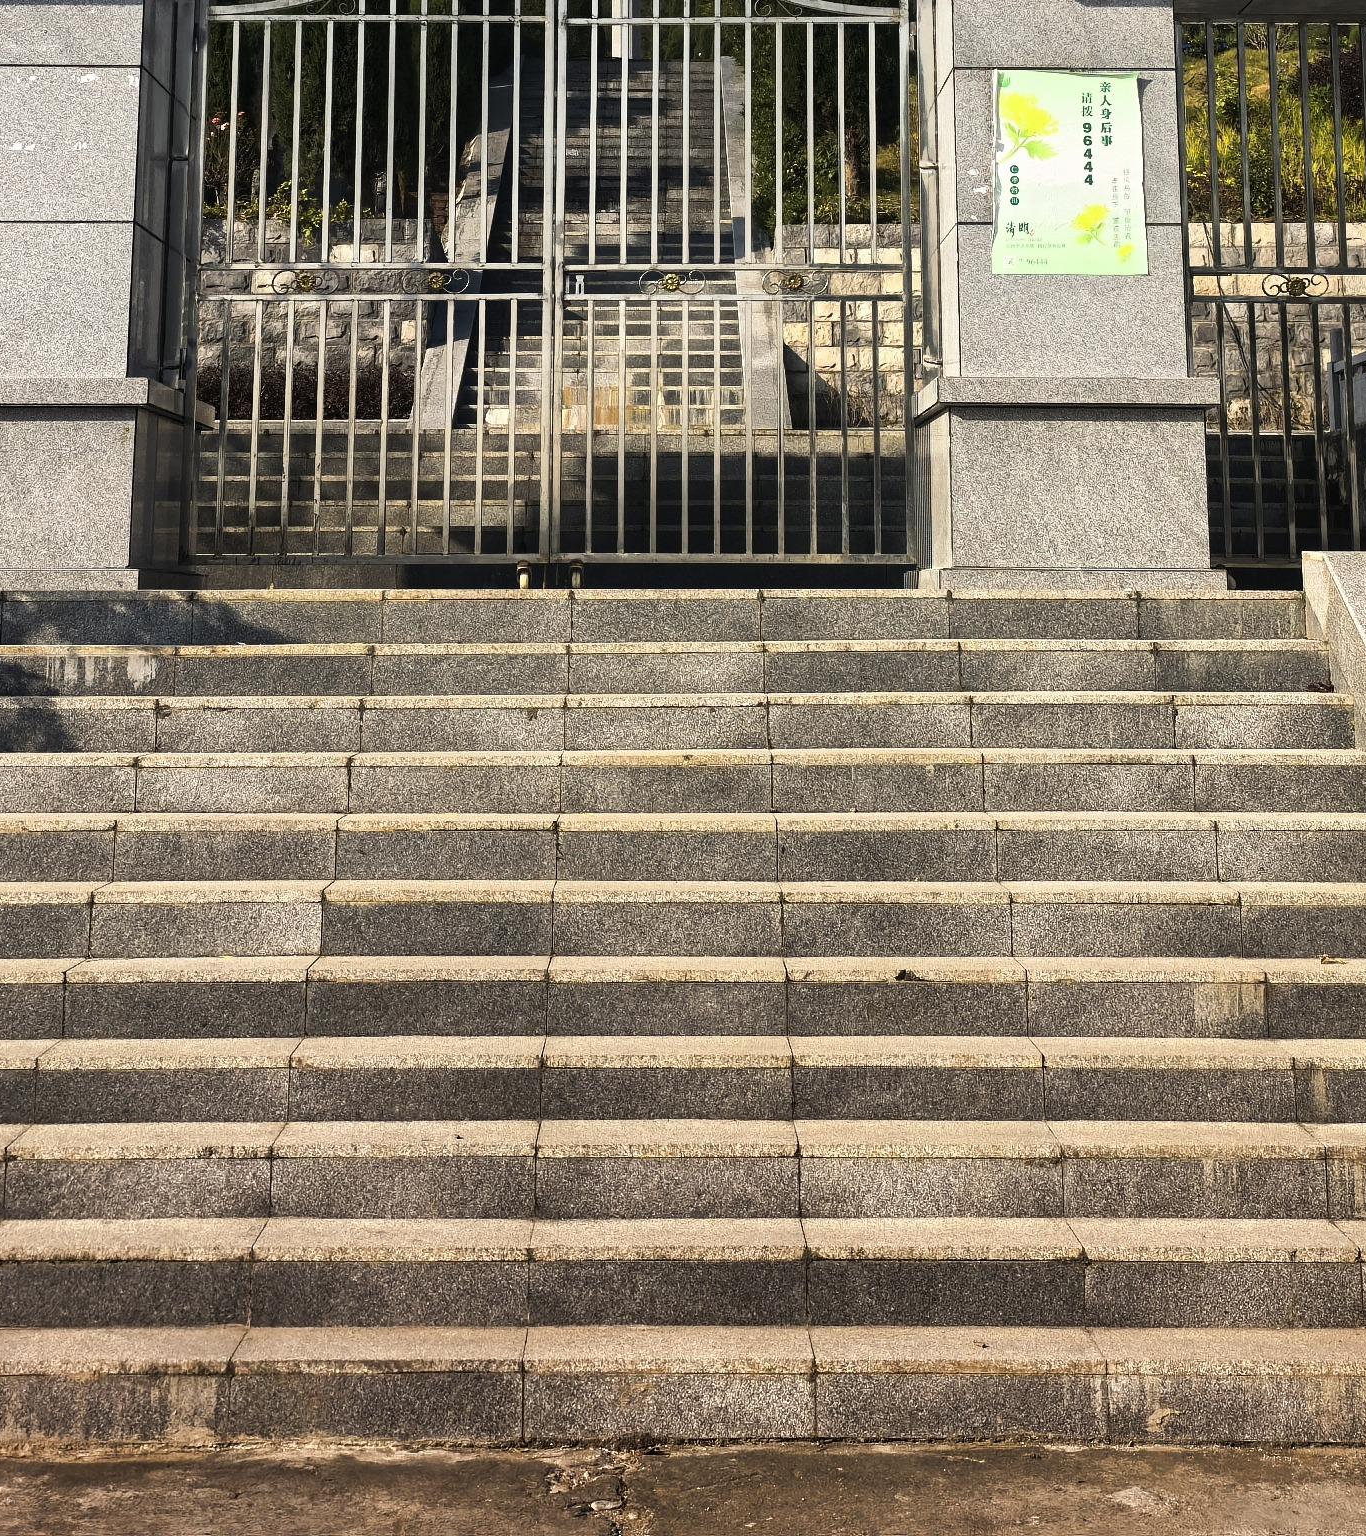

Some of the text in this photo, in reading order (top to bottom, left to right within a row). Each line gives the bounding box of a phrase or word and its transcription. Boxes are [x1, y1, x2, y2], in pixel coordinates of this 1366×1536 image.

[1099, 81, 1113, 147] 亲人身后事
